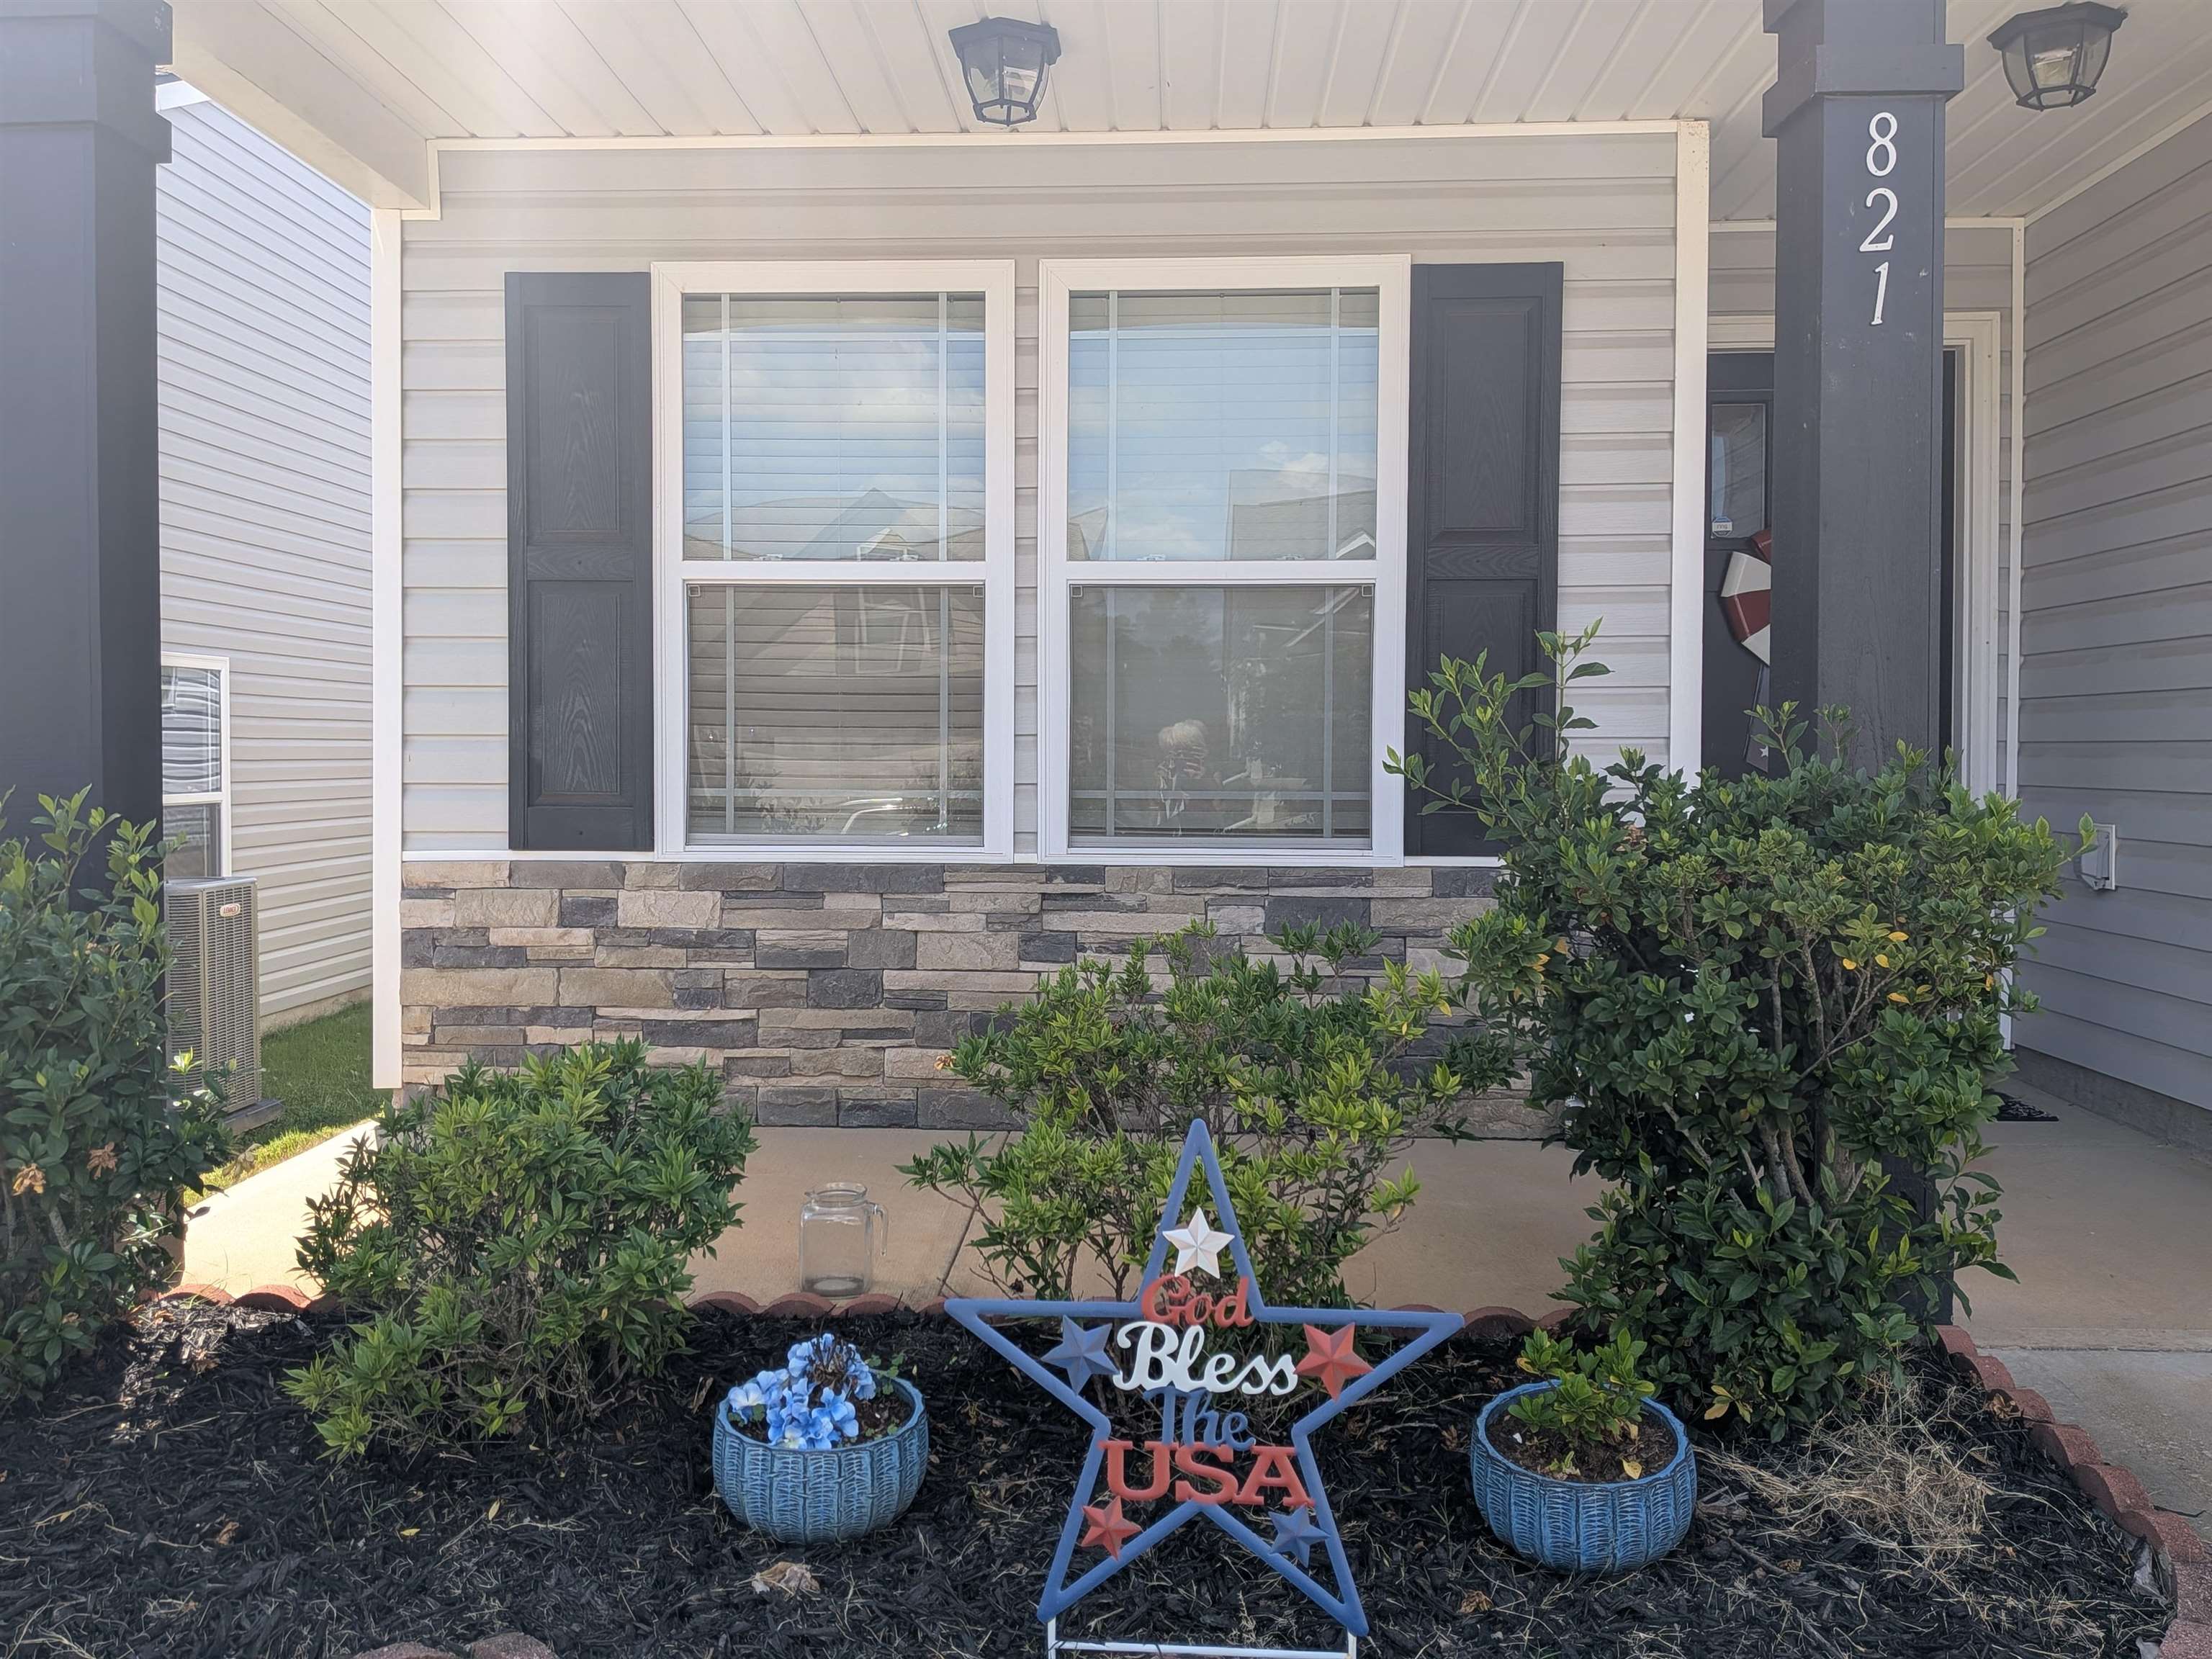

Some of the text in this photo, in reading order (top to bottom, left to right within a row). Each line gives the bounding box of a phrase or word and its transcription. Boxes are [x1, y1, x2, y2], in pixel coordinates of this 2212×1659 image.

[1859, 112, 1898, 325] 821
[1142, 1274, 1254, 1327] God
[1112, 1321, 1298, 1395] Bless
[1143, 1385, 1256, 1450] The
[1099, 1440, 1315, 1506] USA
